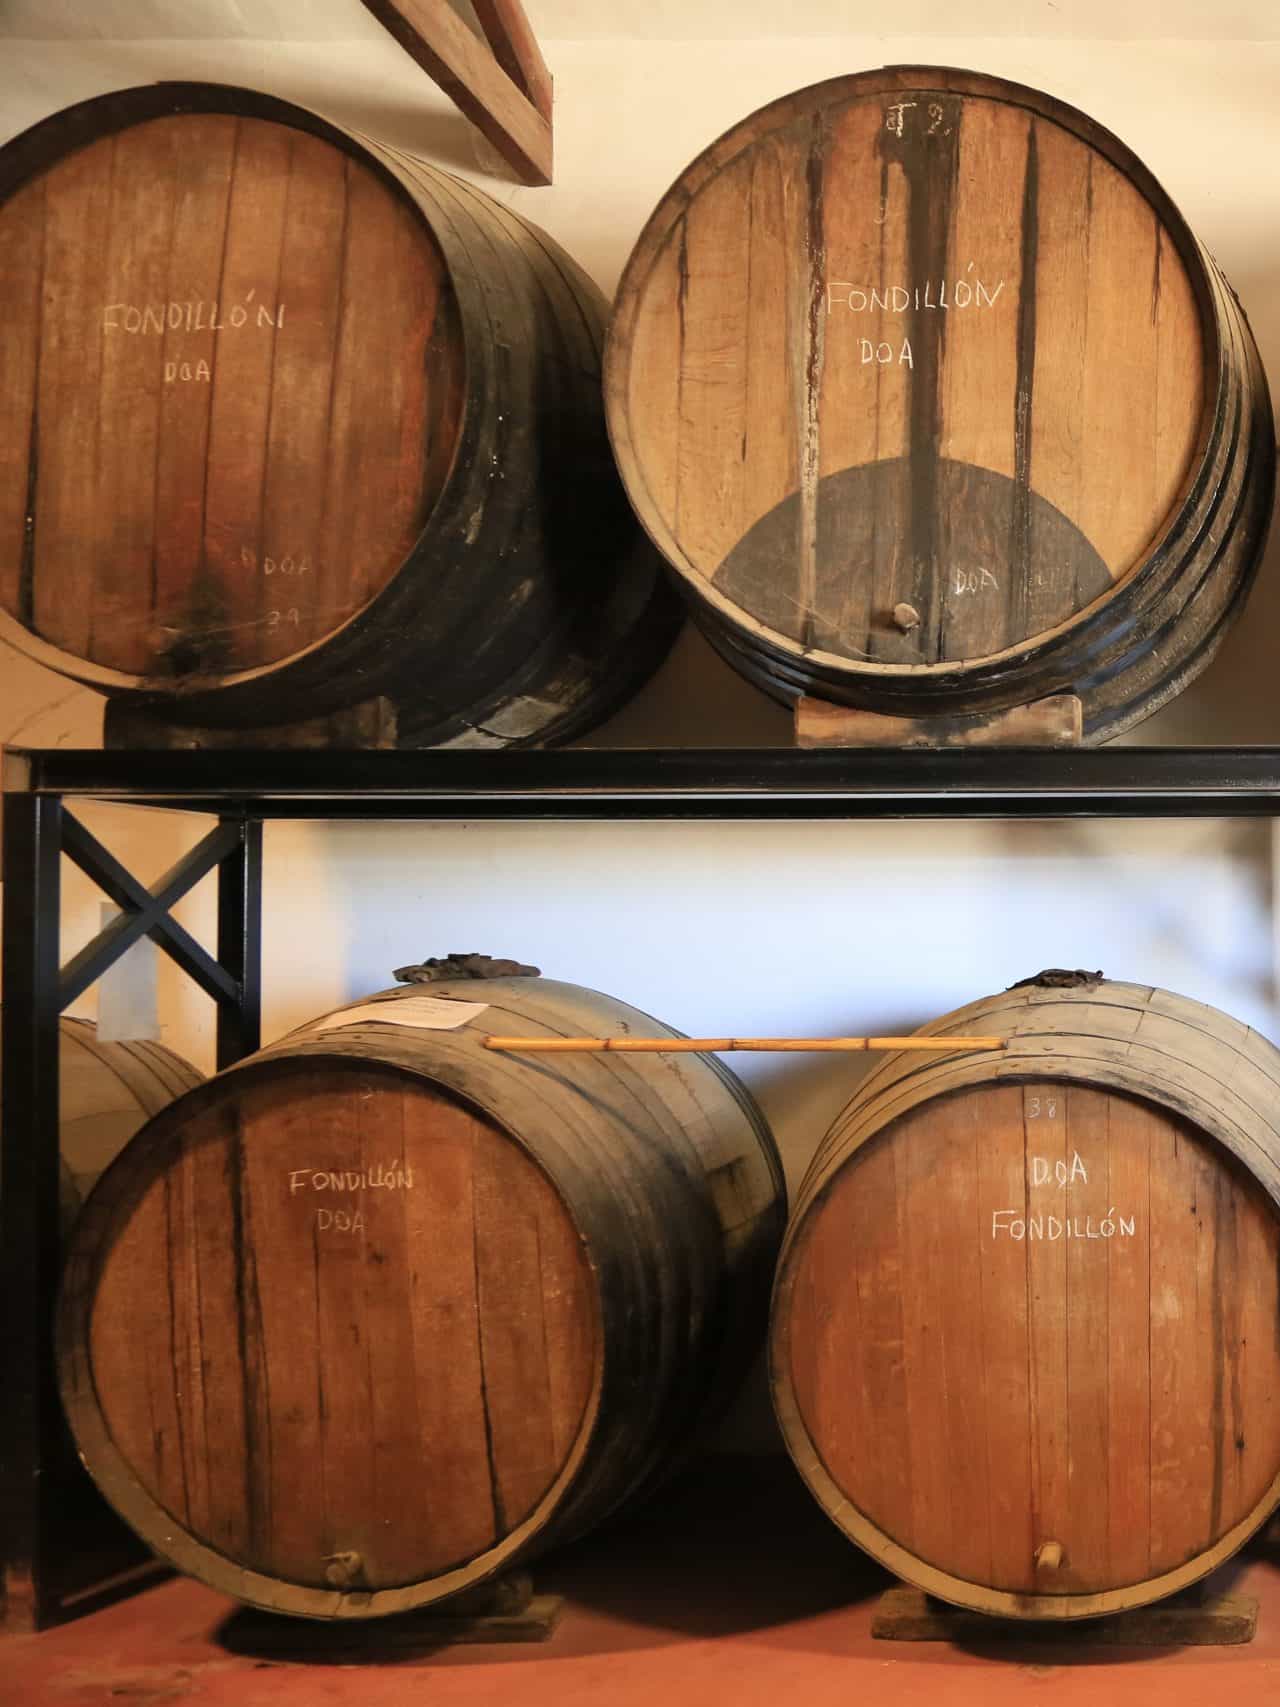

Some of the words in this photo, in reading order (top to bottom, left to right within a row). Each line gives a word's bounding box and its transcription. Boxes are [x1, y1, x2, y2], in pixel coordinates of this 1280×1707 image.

[827, 261, 1005, 314] FONDILLÓN
[104, 288, 285, 335] FONDILLÓN
[858, 337, 914, 369] DOA
[165, 359, 211, 383] DOA
[992, 1207, 1137, 1242] FONDILLÓN
